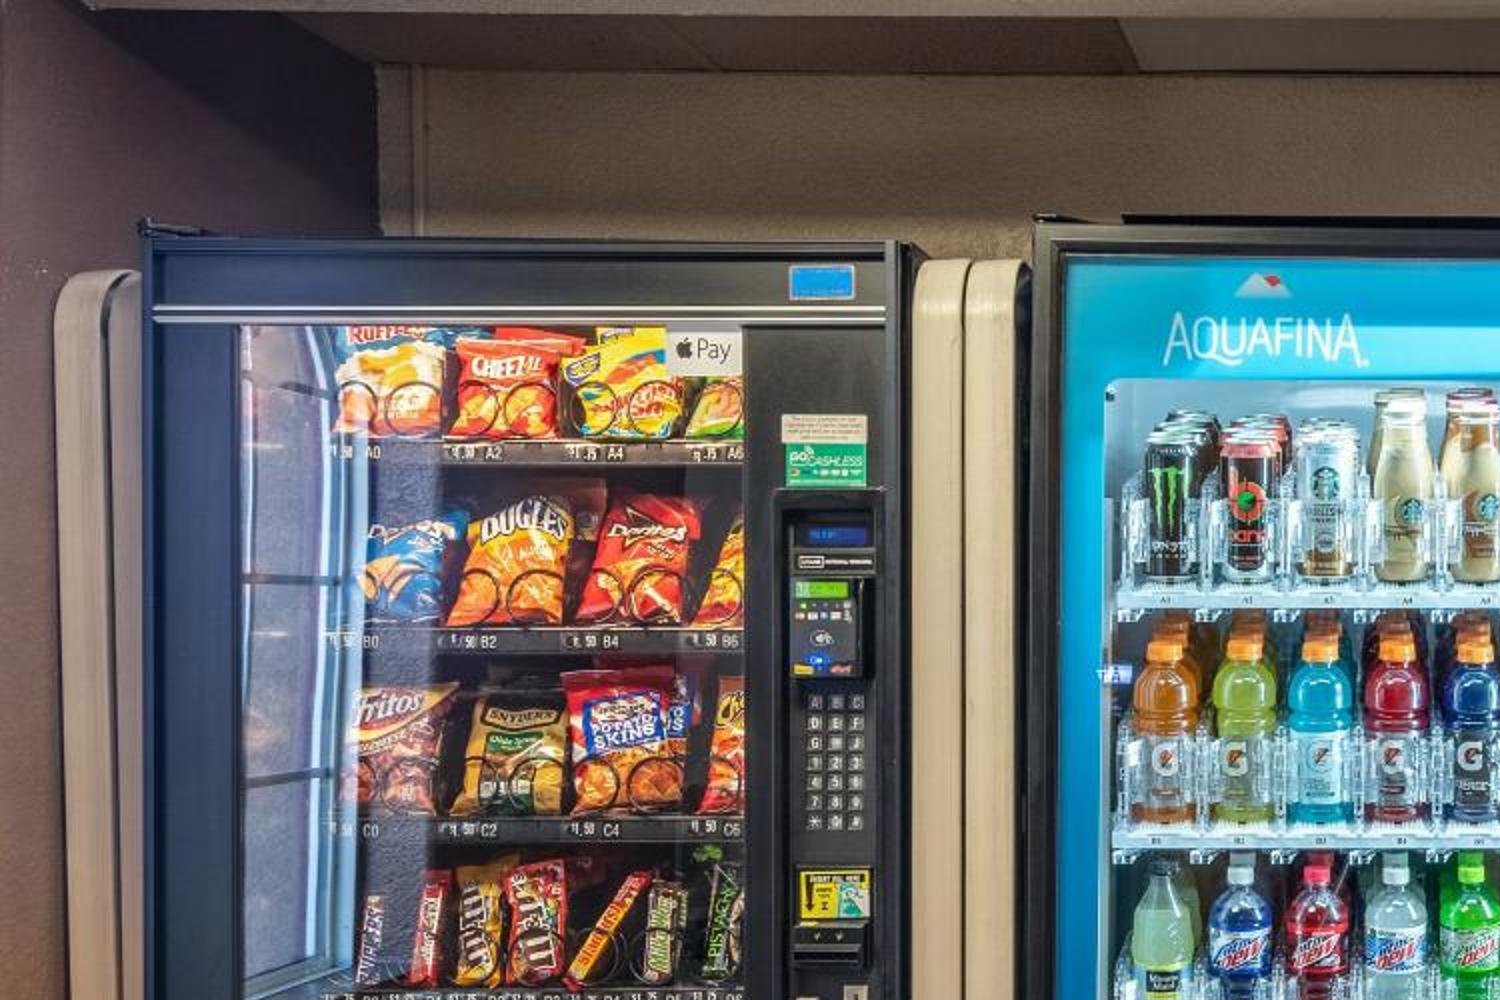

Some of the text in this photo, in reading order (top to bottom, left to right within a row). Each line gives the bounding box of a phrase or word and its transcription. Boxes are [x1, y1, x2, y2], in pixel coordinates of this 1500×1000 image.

[1163, 311, 1364, 368] AQUAFINA
[697, 337, 731, 365] Pay
[485, 446, 503, 459] A2
[607, 447, 624, 459] A4
[480, 496, 566, 546] BUGLES
[607, 523, 688, 545] Doritos
[481, 636, 497, 648] B2
[603, 636, 619, 648] B4
[591, 713, 654, 737] POTATO
[593, 723, 655, 749] SKINS
[363, 824, 379, 837] C0
[481, 824, 497, 837] C2
[603, 824, 619, 837] C4
